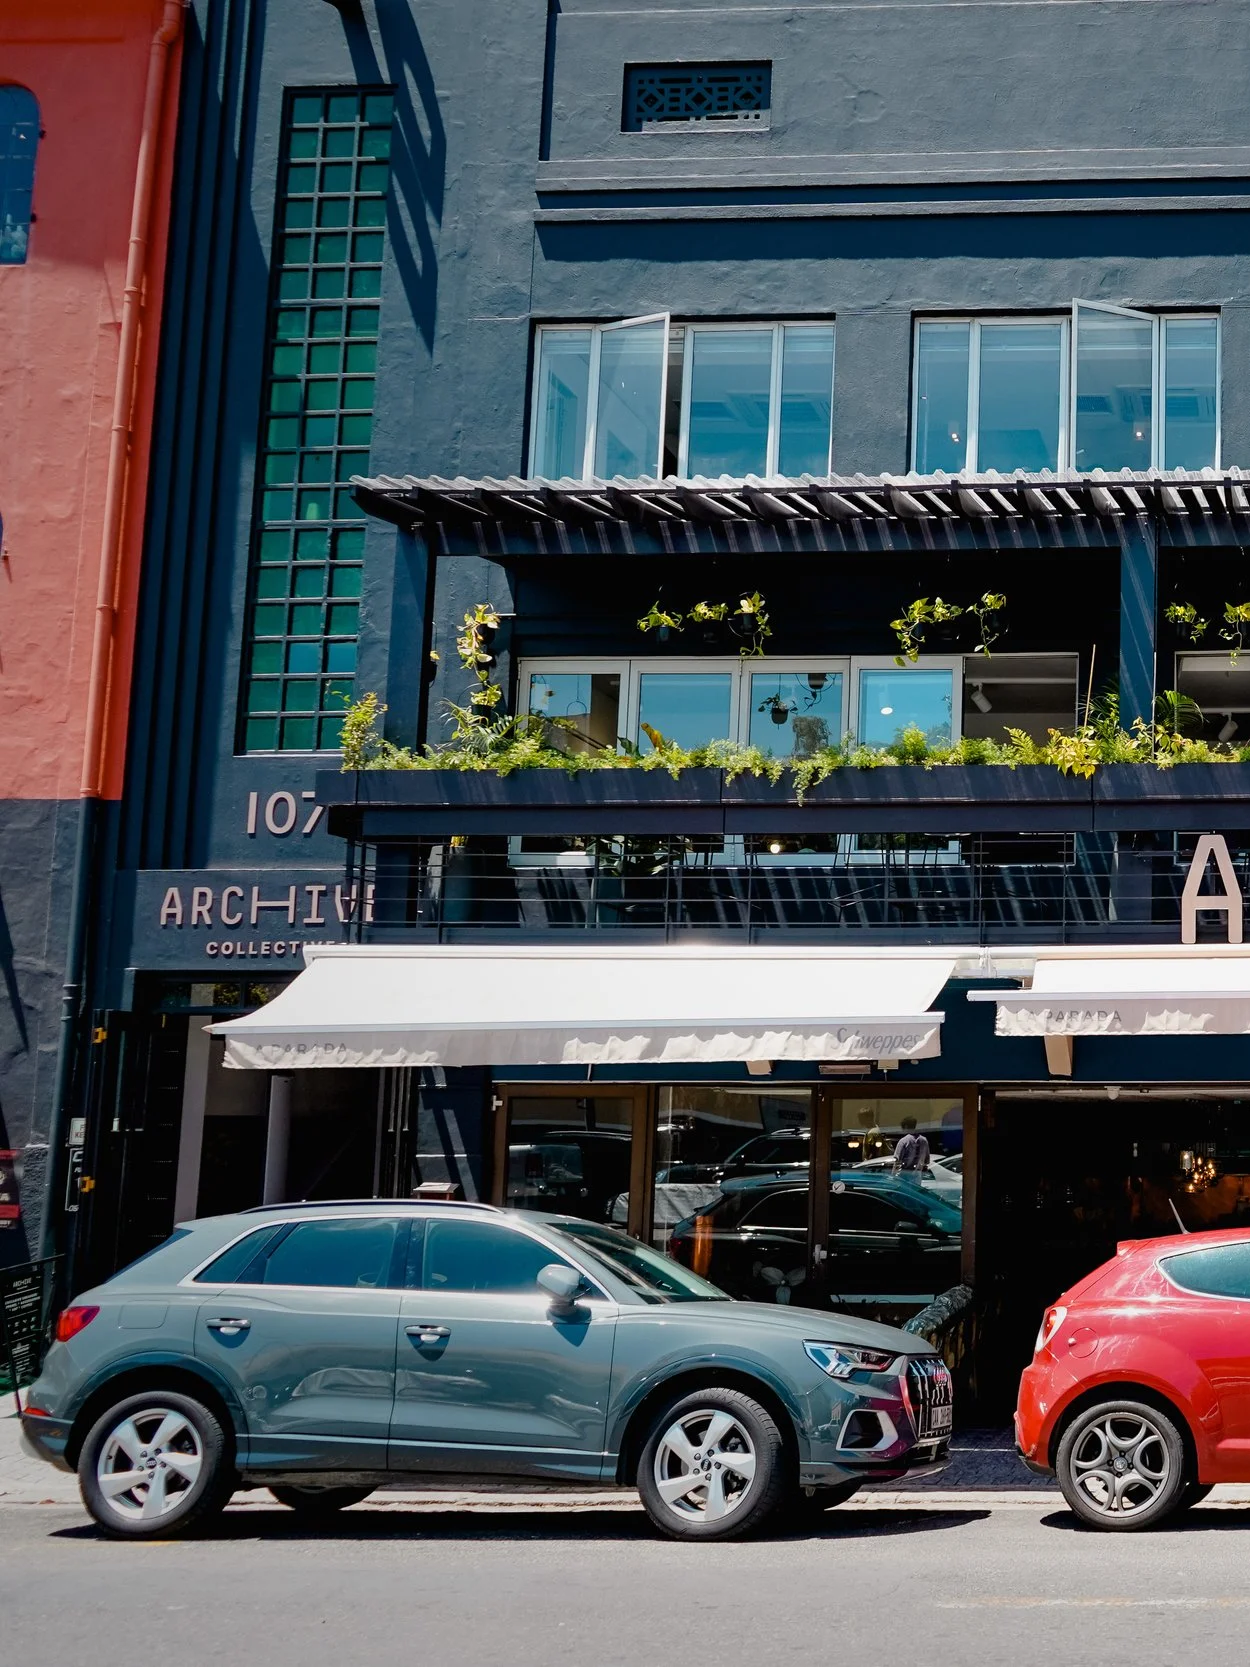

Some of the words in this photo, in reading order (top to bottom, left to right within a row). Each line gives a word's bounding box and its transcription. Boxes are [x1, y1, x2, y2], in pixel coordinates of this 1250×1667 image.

[247, 790, 326, 835] 107
[205, 940, 336, 956] COLLECT
[1045, 1010, 1122, 1023] PARADA
